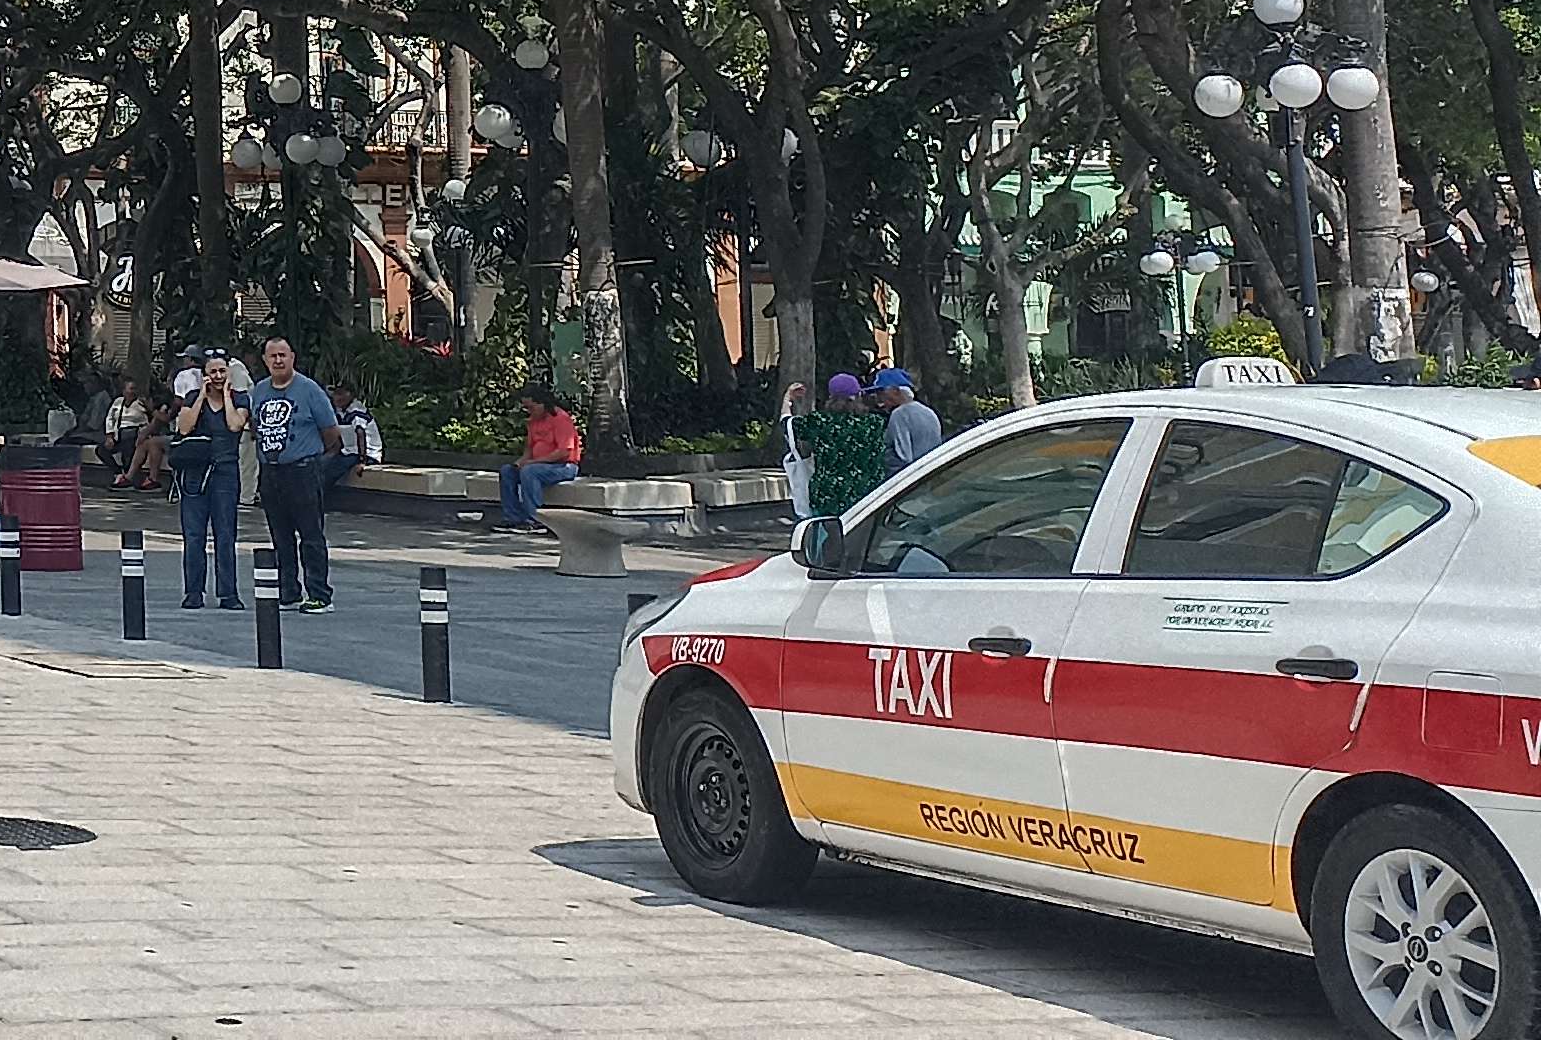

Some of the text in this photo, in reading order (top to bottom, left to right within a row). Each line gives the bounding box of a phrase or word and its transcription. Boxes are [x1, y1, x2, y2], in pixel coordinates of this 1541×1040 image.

[1221, 364, 1284, 384] TAXI
[671, 636, 725, 664] VB-9270
[868, 647, 954, 720] TAXI
[919, 800, 1146, 865] REGIÓN VERACRUZ
